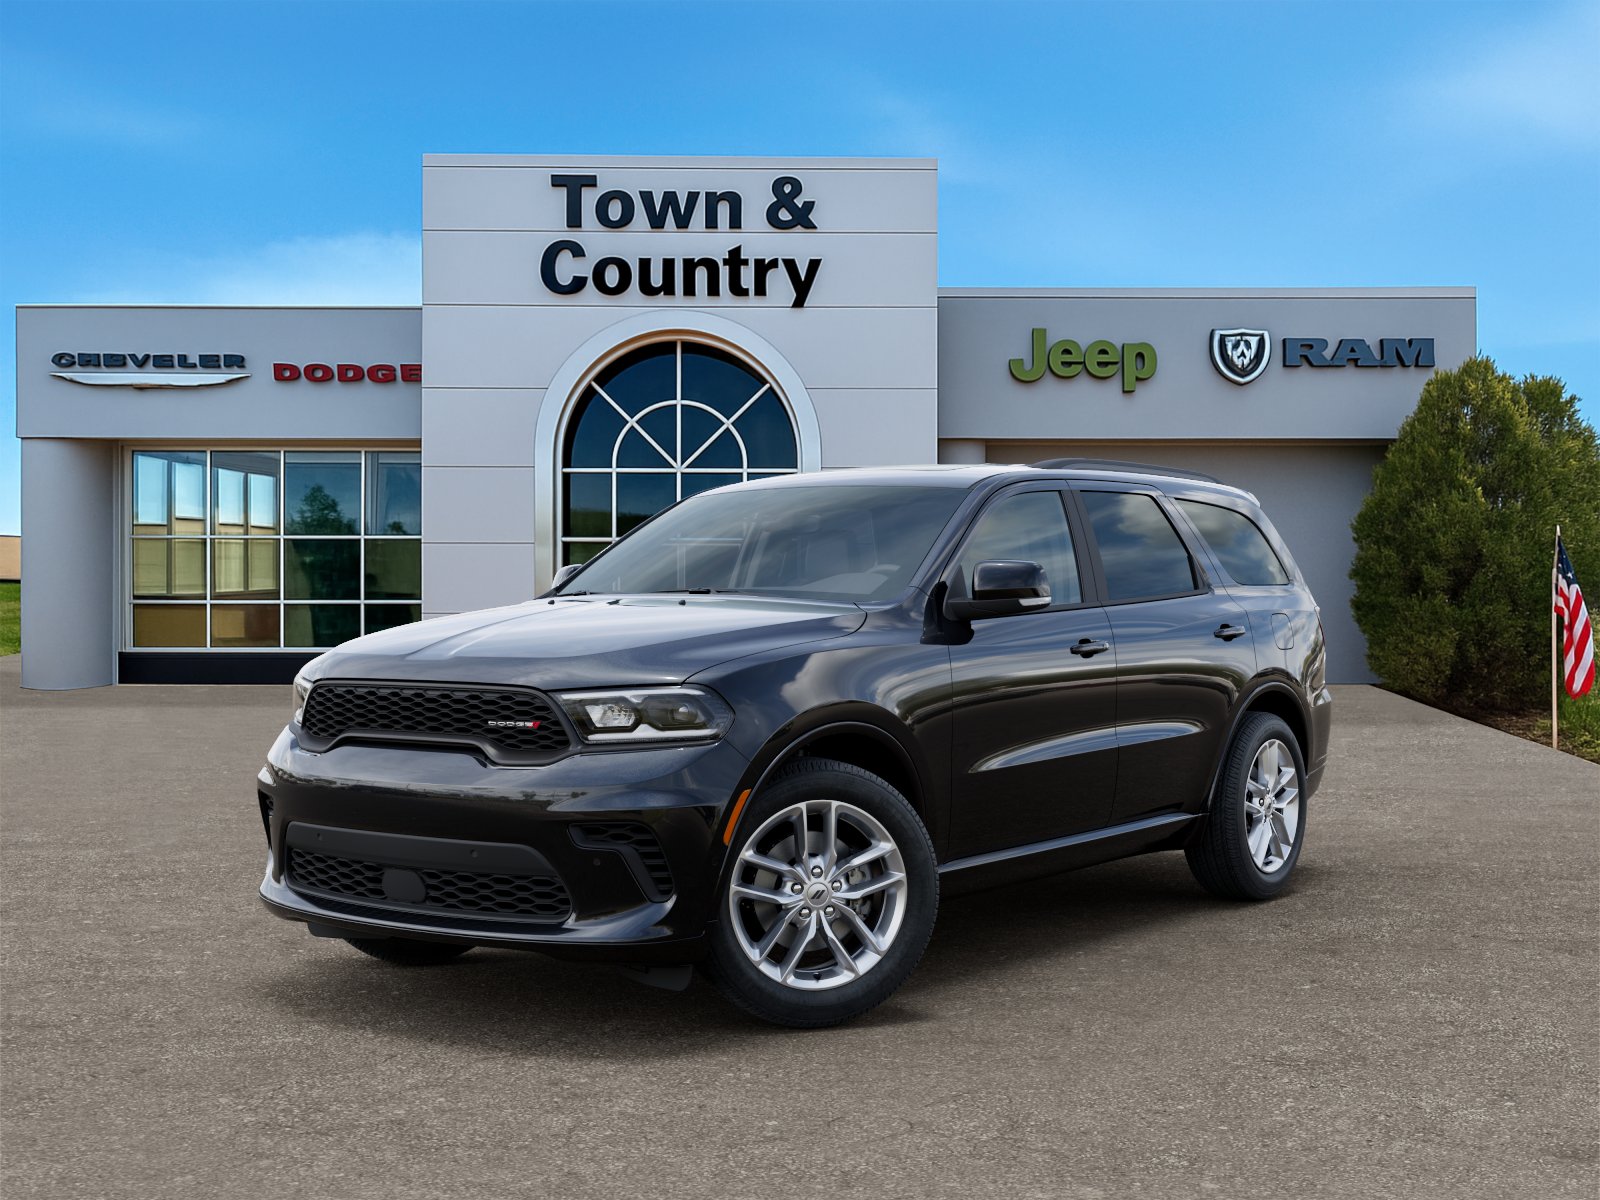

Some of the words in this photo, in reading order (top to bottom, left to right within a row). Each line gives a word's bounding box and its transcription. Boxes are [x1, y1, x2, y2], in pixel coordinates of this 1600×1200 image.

[550, 174, 743, 229] Town
[765, 176, 818, 230] &
[540, 239, 823, 308] Country
[273, 363, 422, 383] DODGE
[1009, 328, 1158, 393] Jeep
[1283, 338, 1436, 368] RAM
[488, 720, 534, 728] DODGE
